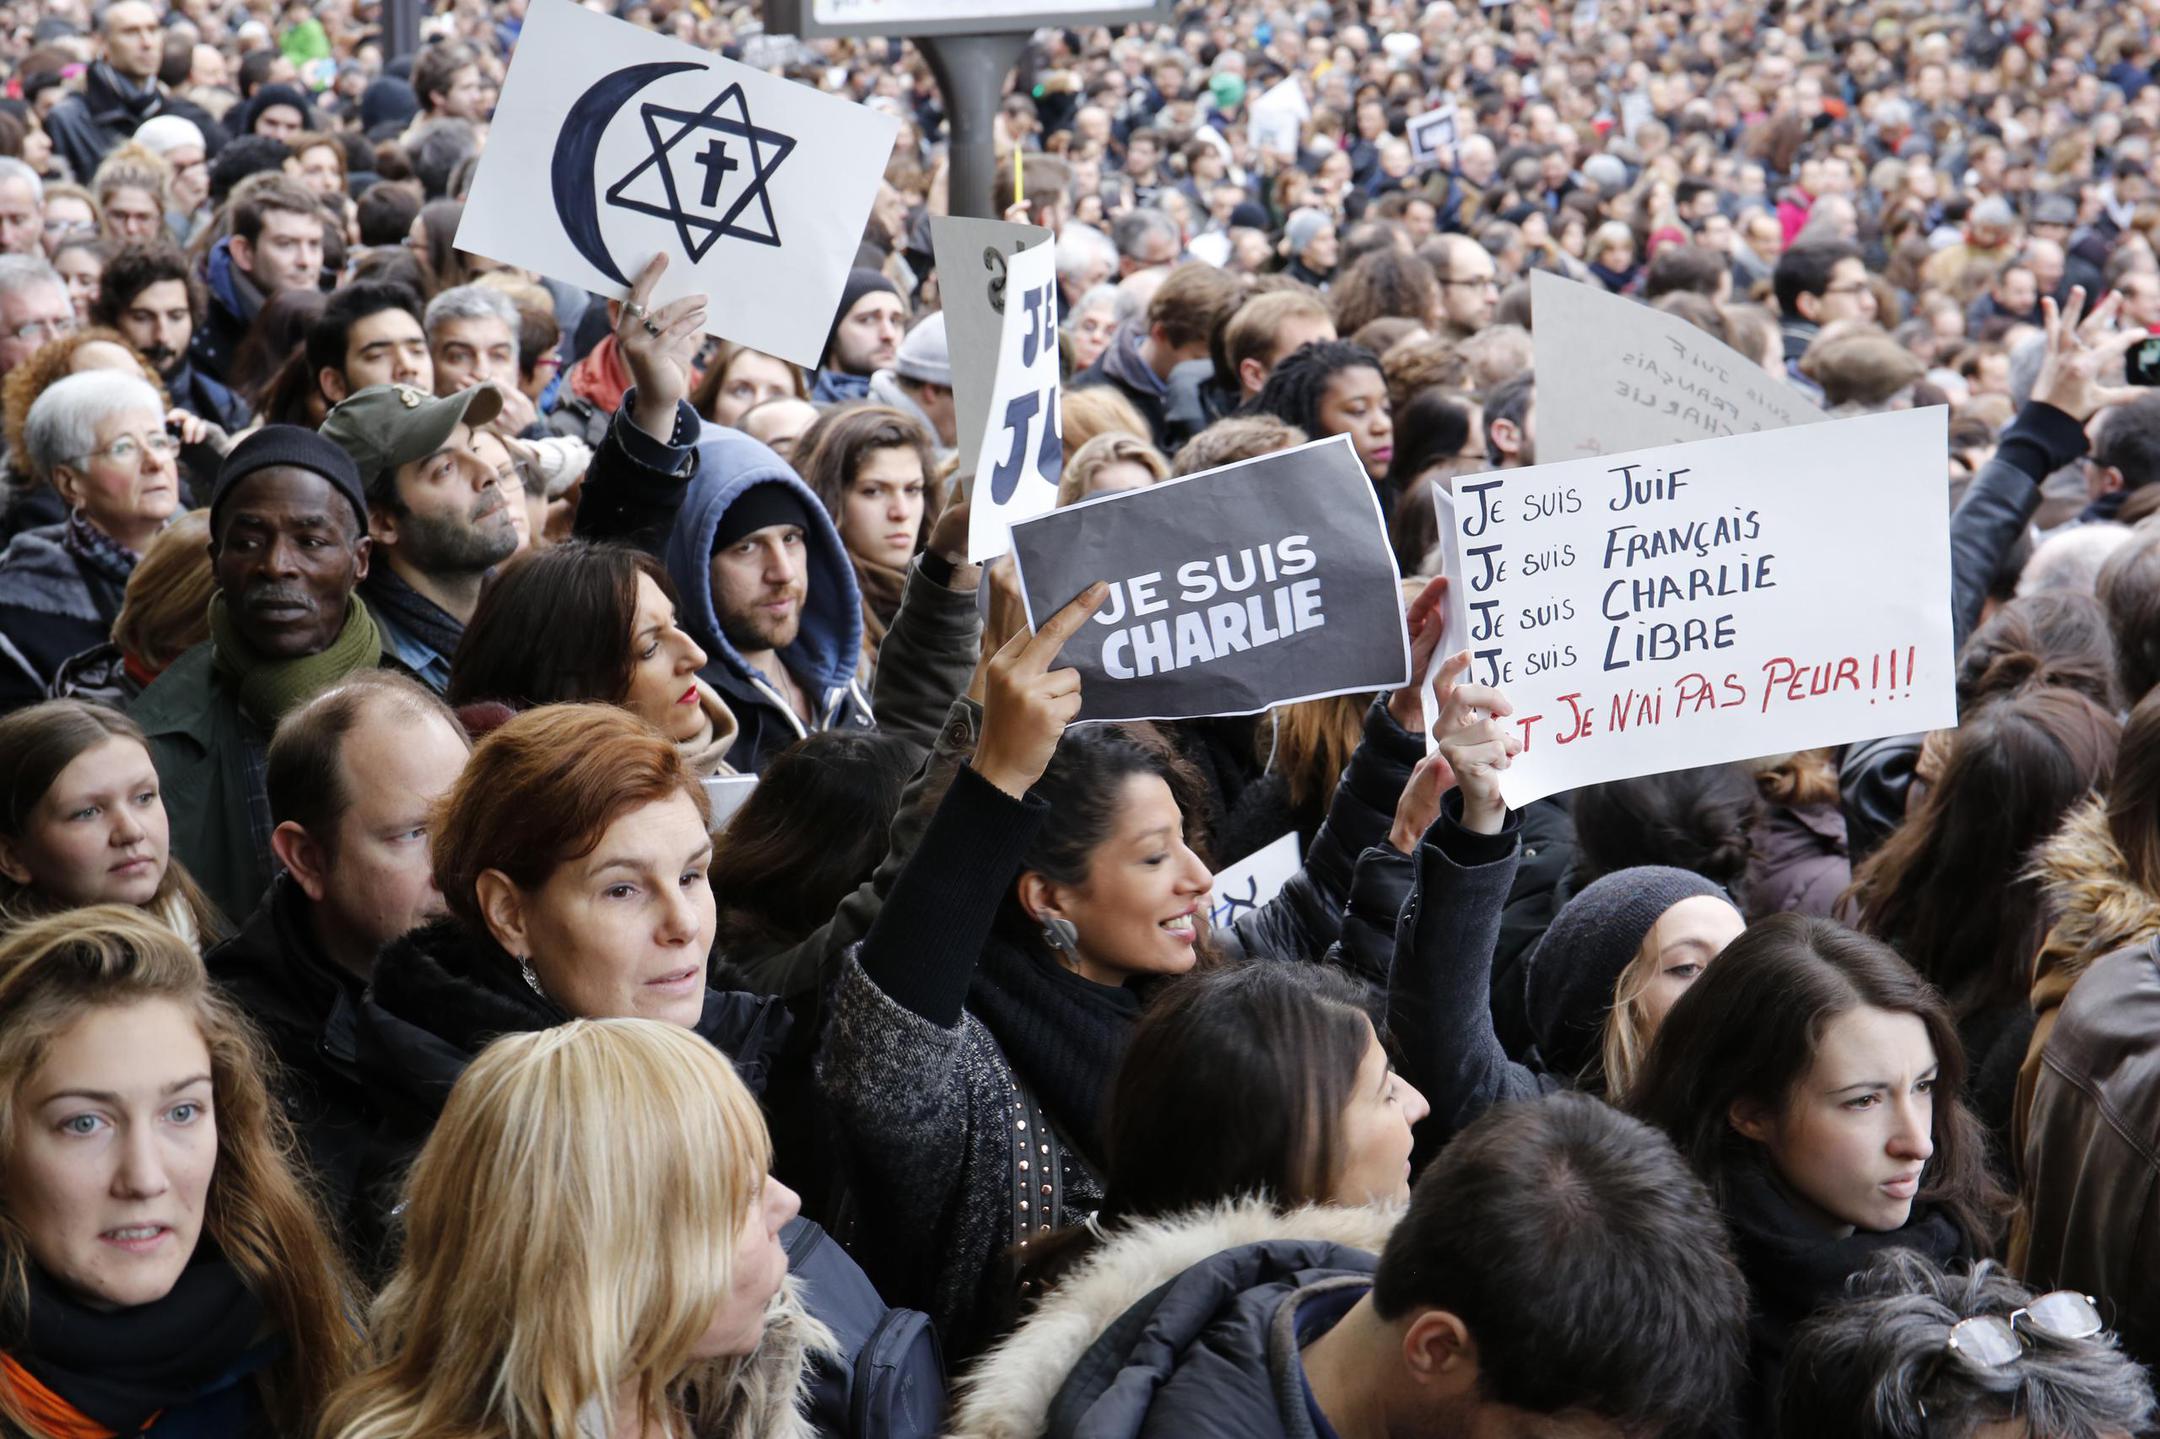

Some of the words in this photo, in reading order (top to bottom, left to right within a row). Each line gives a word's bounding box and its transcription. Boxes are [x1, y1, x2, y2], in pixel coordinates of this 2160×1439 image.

[1023, 278, 1056, 368] JE
[1462, 480, 1505, 537] JE
[1092, 571, 1169, 626] JE
[1177, 535, 1317, 602] SUIS
[1467, 543, 1508, 593] JE
[1101, 578, 1325, 680] CHARLIE
[1469, 599, 1505, 642] JE
[1474, 647, 1514, 688] JE
[1555, 692, 1595, 745] JE
[1674, 673, 1747, 719] PAS
